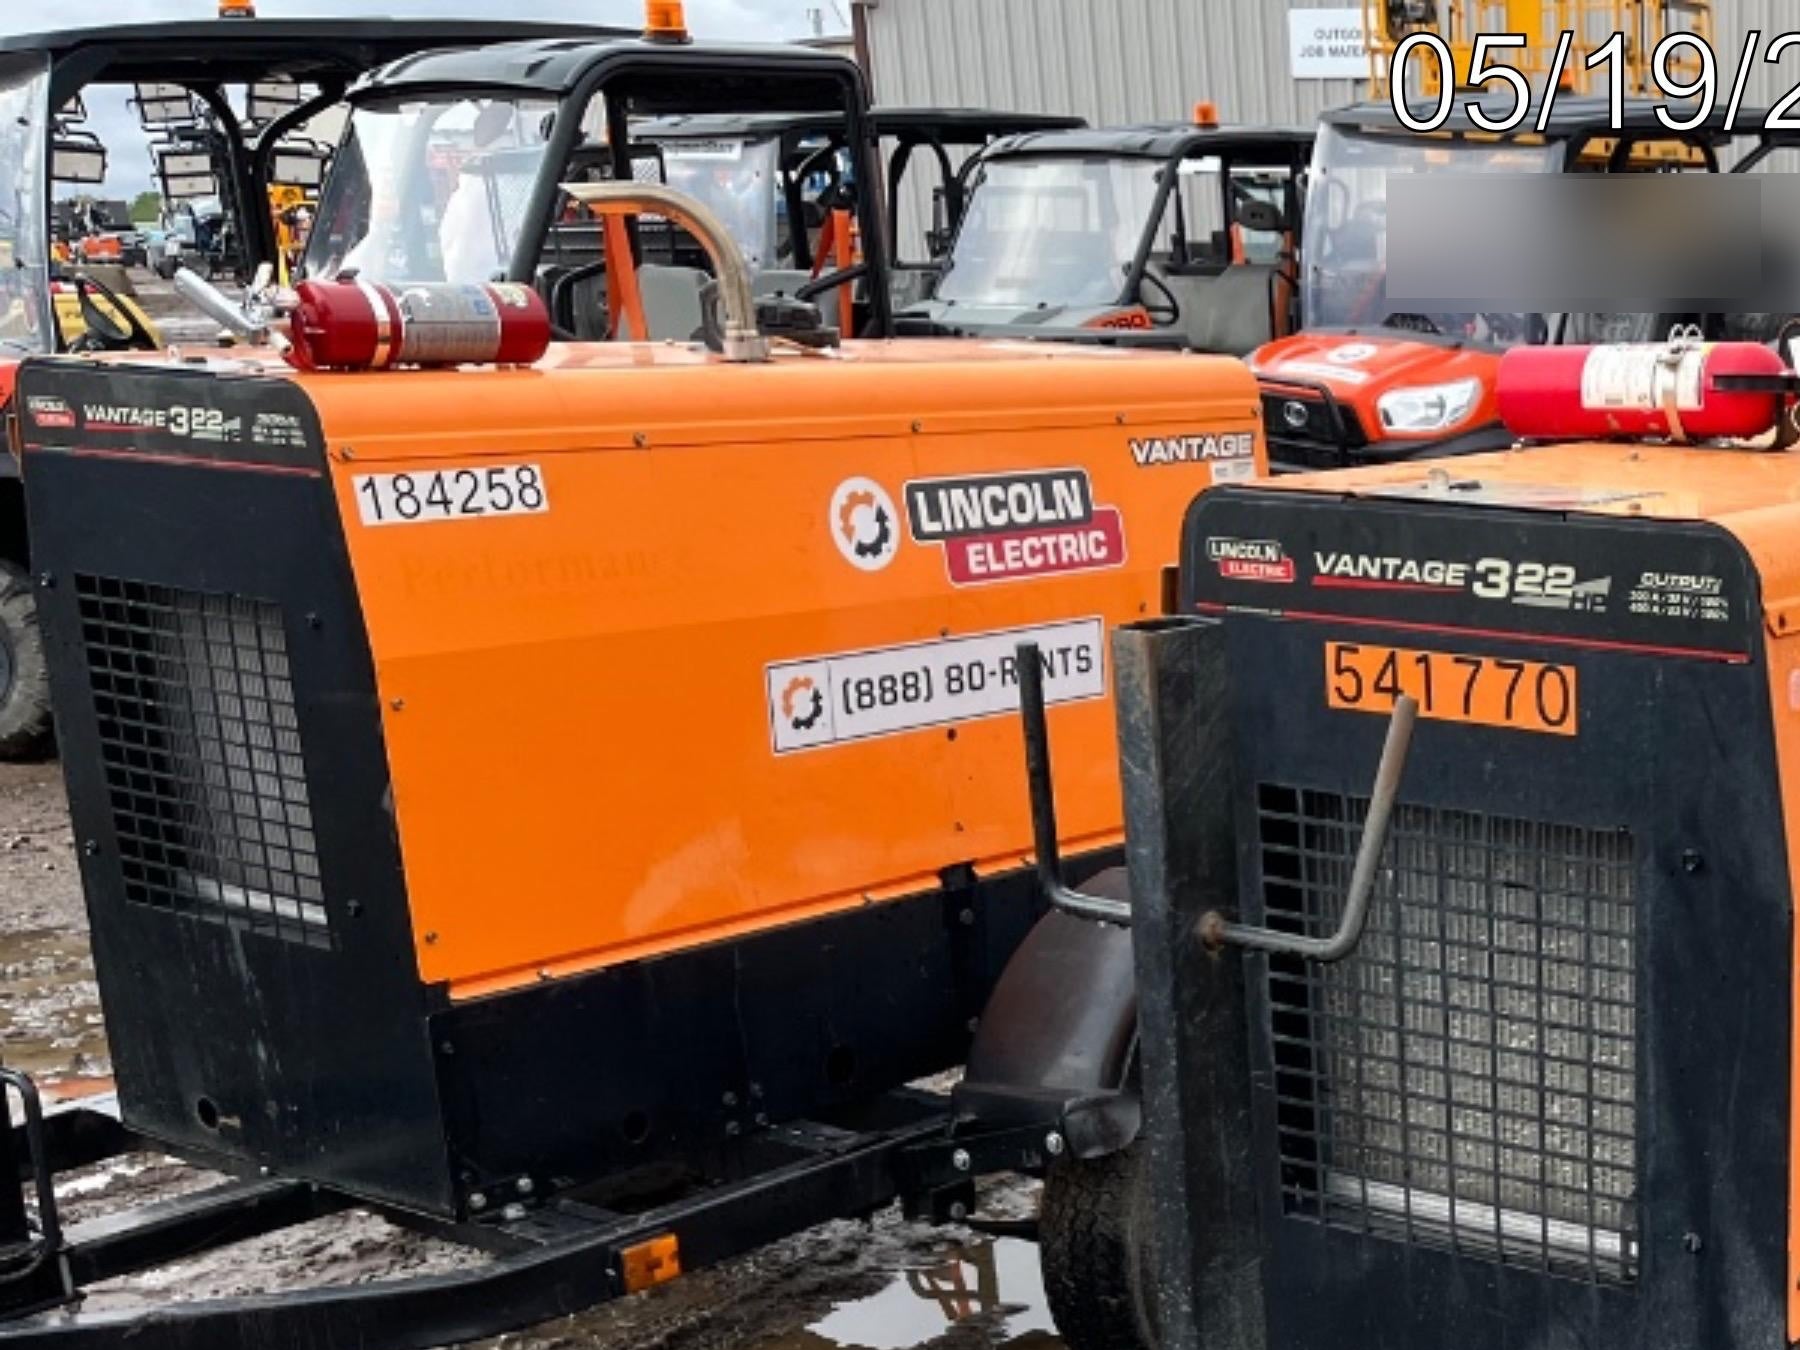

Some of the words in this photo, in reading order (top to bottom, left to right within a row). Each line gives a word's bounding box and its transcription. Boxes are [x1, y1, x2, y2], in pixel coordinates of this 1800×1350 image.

[84, 403, 167, 428] VANTAGE
[169, 406, 224, 436] 322
[1130, 433, 1254, 464] VANTAGE
[361, 464, 543, 521] 184258
[914, 478, 1086, 533] LINCOLN
[966, 530, 1110, 575] ELECTRIC
[1211, 540, 1280, 562] LINCOLN
[1228, 561, 1289, 578] ELECTRIC
[1313, 551, 1473, 587] VANTAGE
[1472, 557, 1577, 600] 322
[1640, 571, 1720, 591] OUTPUT
[842, 668, 933, 716] (888)
[945, 645, 1093, 695] 80-RNTS
[1333, 645, 1570, 728] 541770
